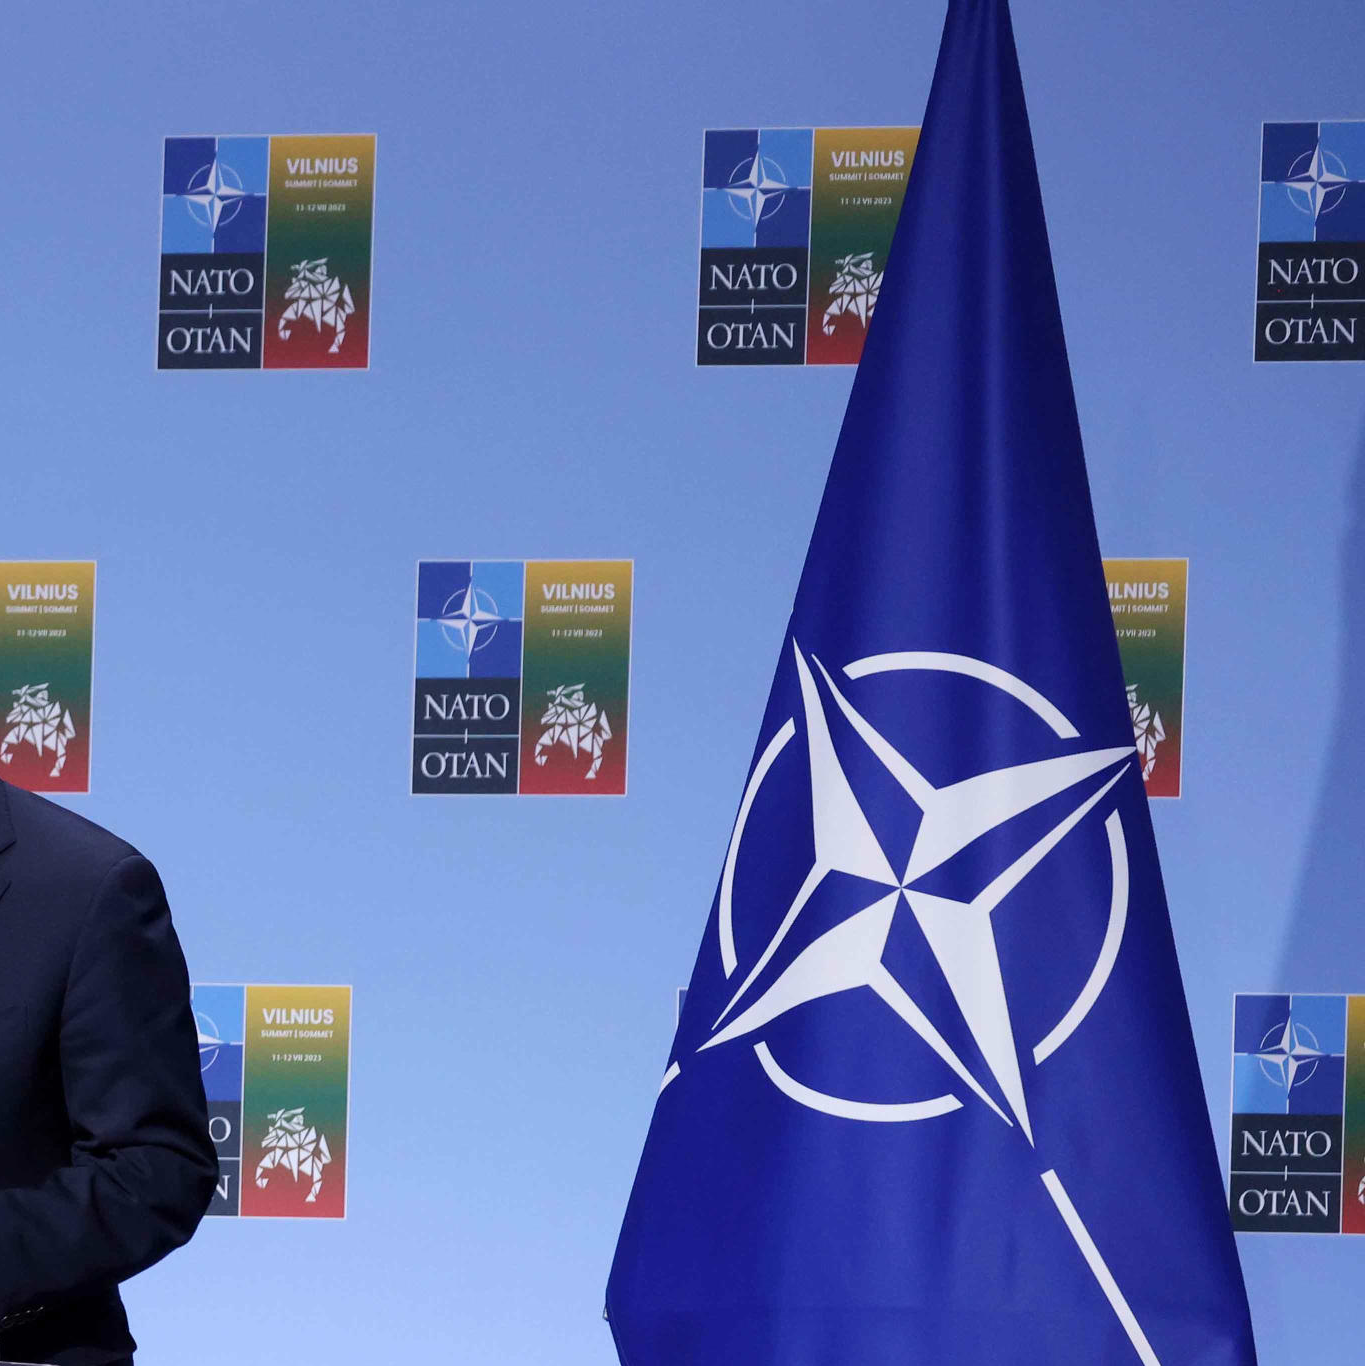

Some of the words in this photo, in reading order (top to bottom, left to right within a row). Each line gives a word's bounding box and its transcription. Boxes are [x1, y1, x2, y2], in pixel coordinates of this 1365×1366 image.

[286, 157, 358, 174] VILNIUS
[831, 150, 904, 168] VILNIUS
[170, 269, 254, 294] NATO
[711, 264, 797, 289] NATO
[1269, 258, 1358, 284] NATO
[167, 327, 251, 353] OTAN
[707, 323, 794, 348] OTAN
[1265, 318, 1356, 344] OTAN
[7, 583, 78, 600] VILNIUS
[542, 583, 615, 600] VILNIUS
[1106, 582, 1169, 599] ILNIUS
[425, 694, 509, 719] NATO
[421, 752, 508, 778] OTAN
[262, 1008, 334, 1025] VILNIUS
[1242, 1130, 1331, 1156] NATO
[1239, 1189, 1330, 1216] OTAN
